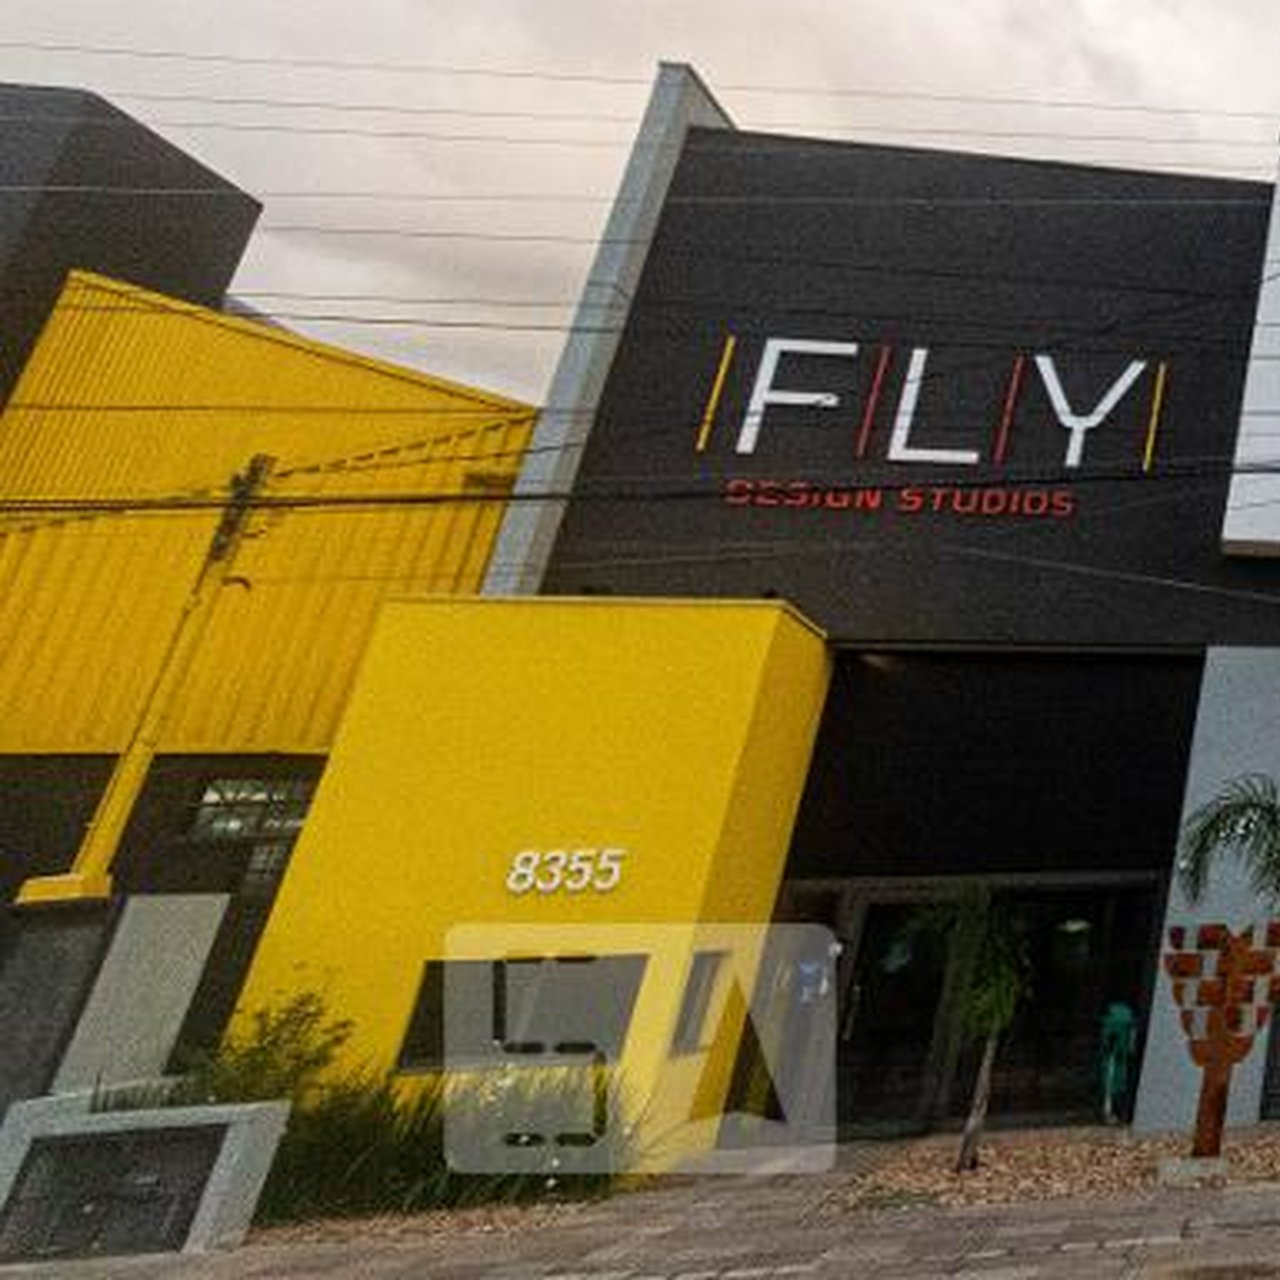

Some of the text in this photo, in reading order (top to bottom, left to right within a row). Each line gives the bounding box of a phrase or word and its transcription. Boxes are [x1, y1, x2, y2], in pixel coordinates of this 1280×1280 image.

[736, 337, 1147, 468] FLY
[724, 478, 1076, 517] DESIGN STUDIOS
[506, 847, 627, 895] 8355
